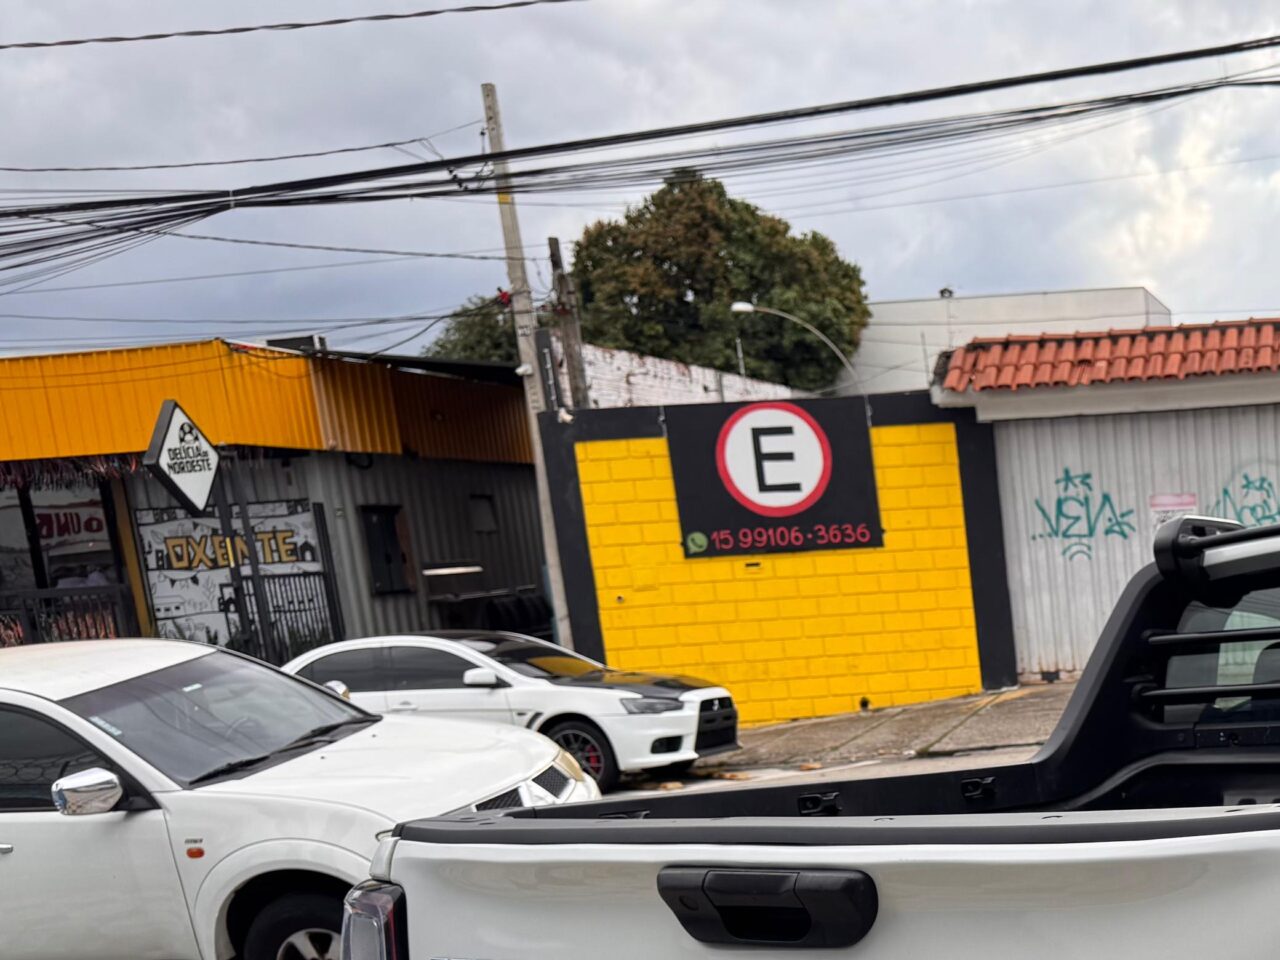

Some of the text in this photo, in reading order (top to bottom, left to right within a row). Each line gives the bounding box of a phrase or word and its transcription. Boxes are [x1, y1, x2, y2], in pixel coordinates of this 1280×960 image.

[752, 426, 802, 493] E
[164, 530, 299, 570] OXENTE
[711, 529, 734, 550] 15
